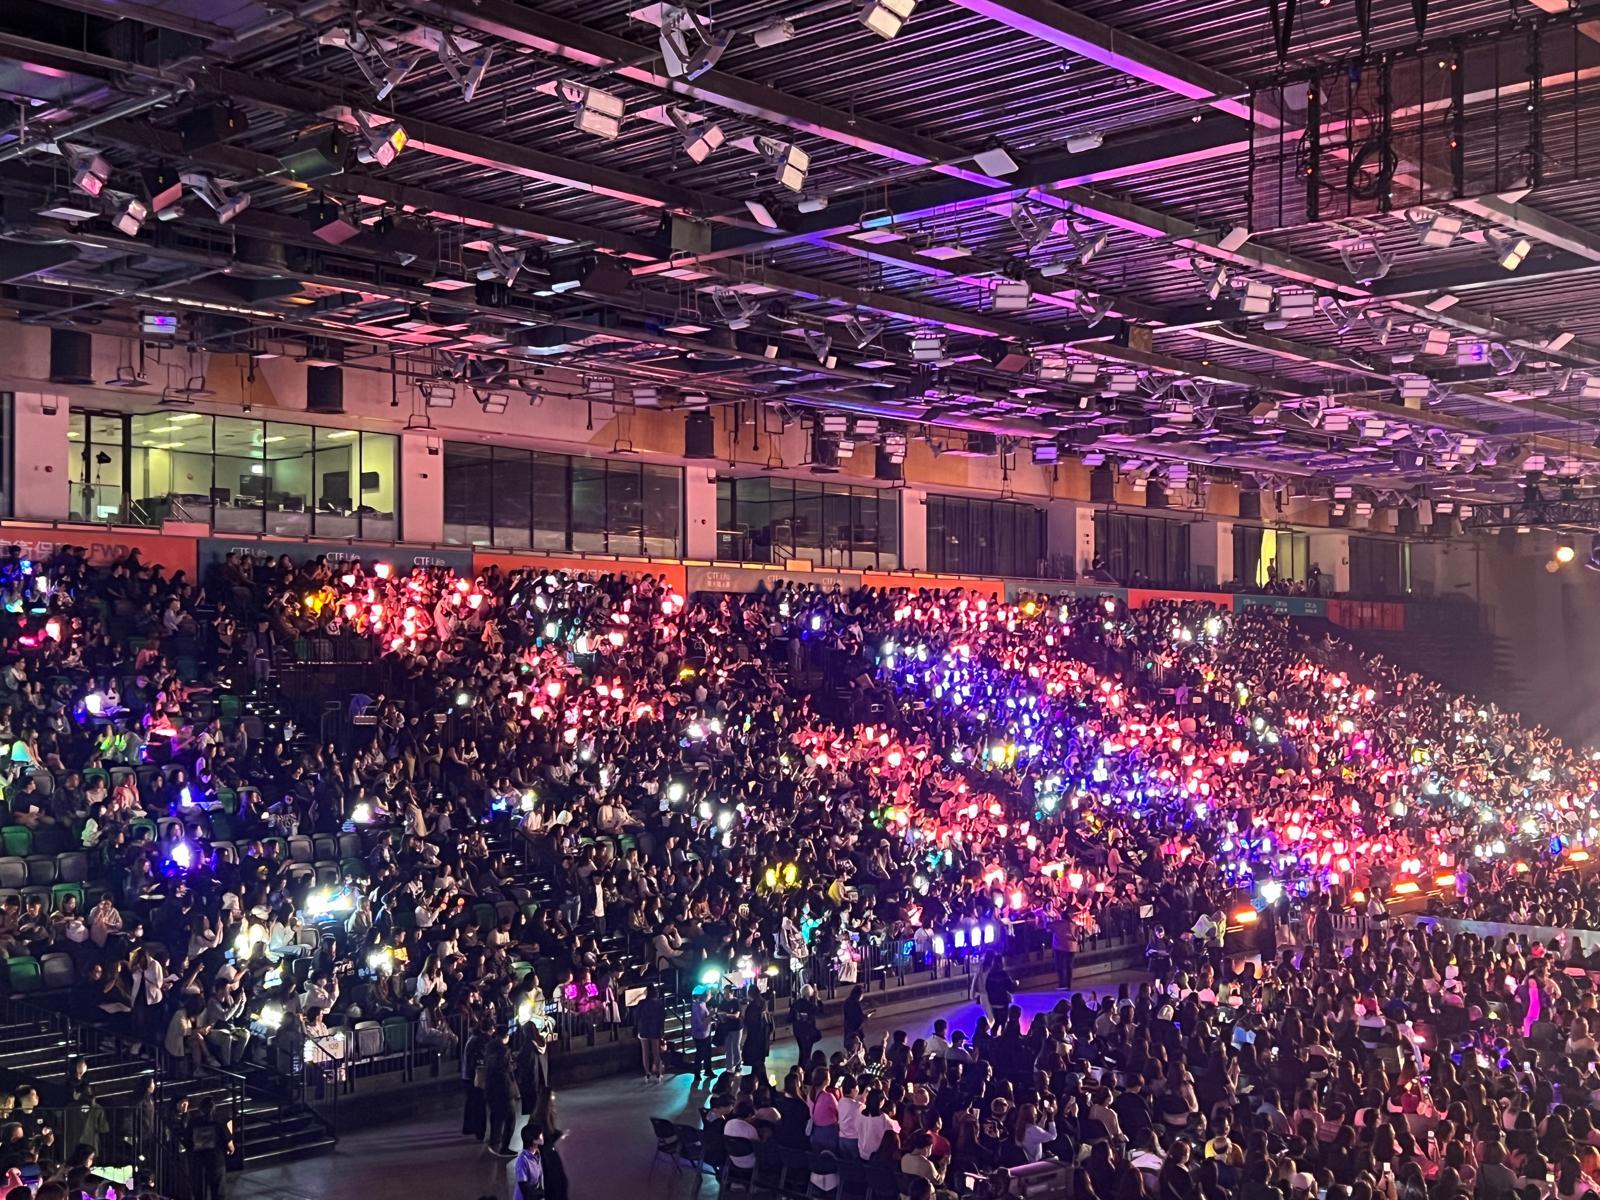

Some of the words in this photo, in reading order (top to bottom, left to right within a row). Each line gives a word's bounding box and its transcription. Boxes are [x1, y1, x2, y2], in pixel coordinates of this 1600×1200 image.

[90, 543, 129, 559] FWD
[326, 552, 345, 561] CTF
[413, 556, 430, 566] CTF
